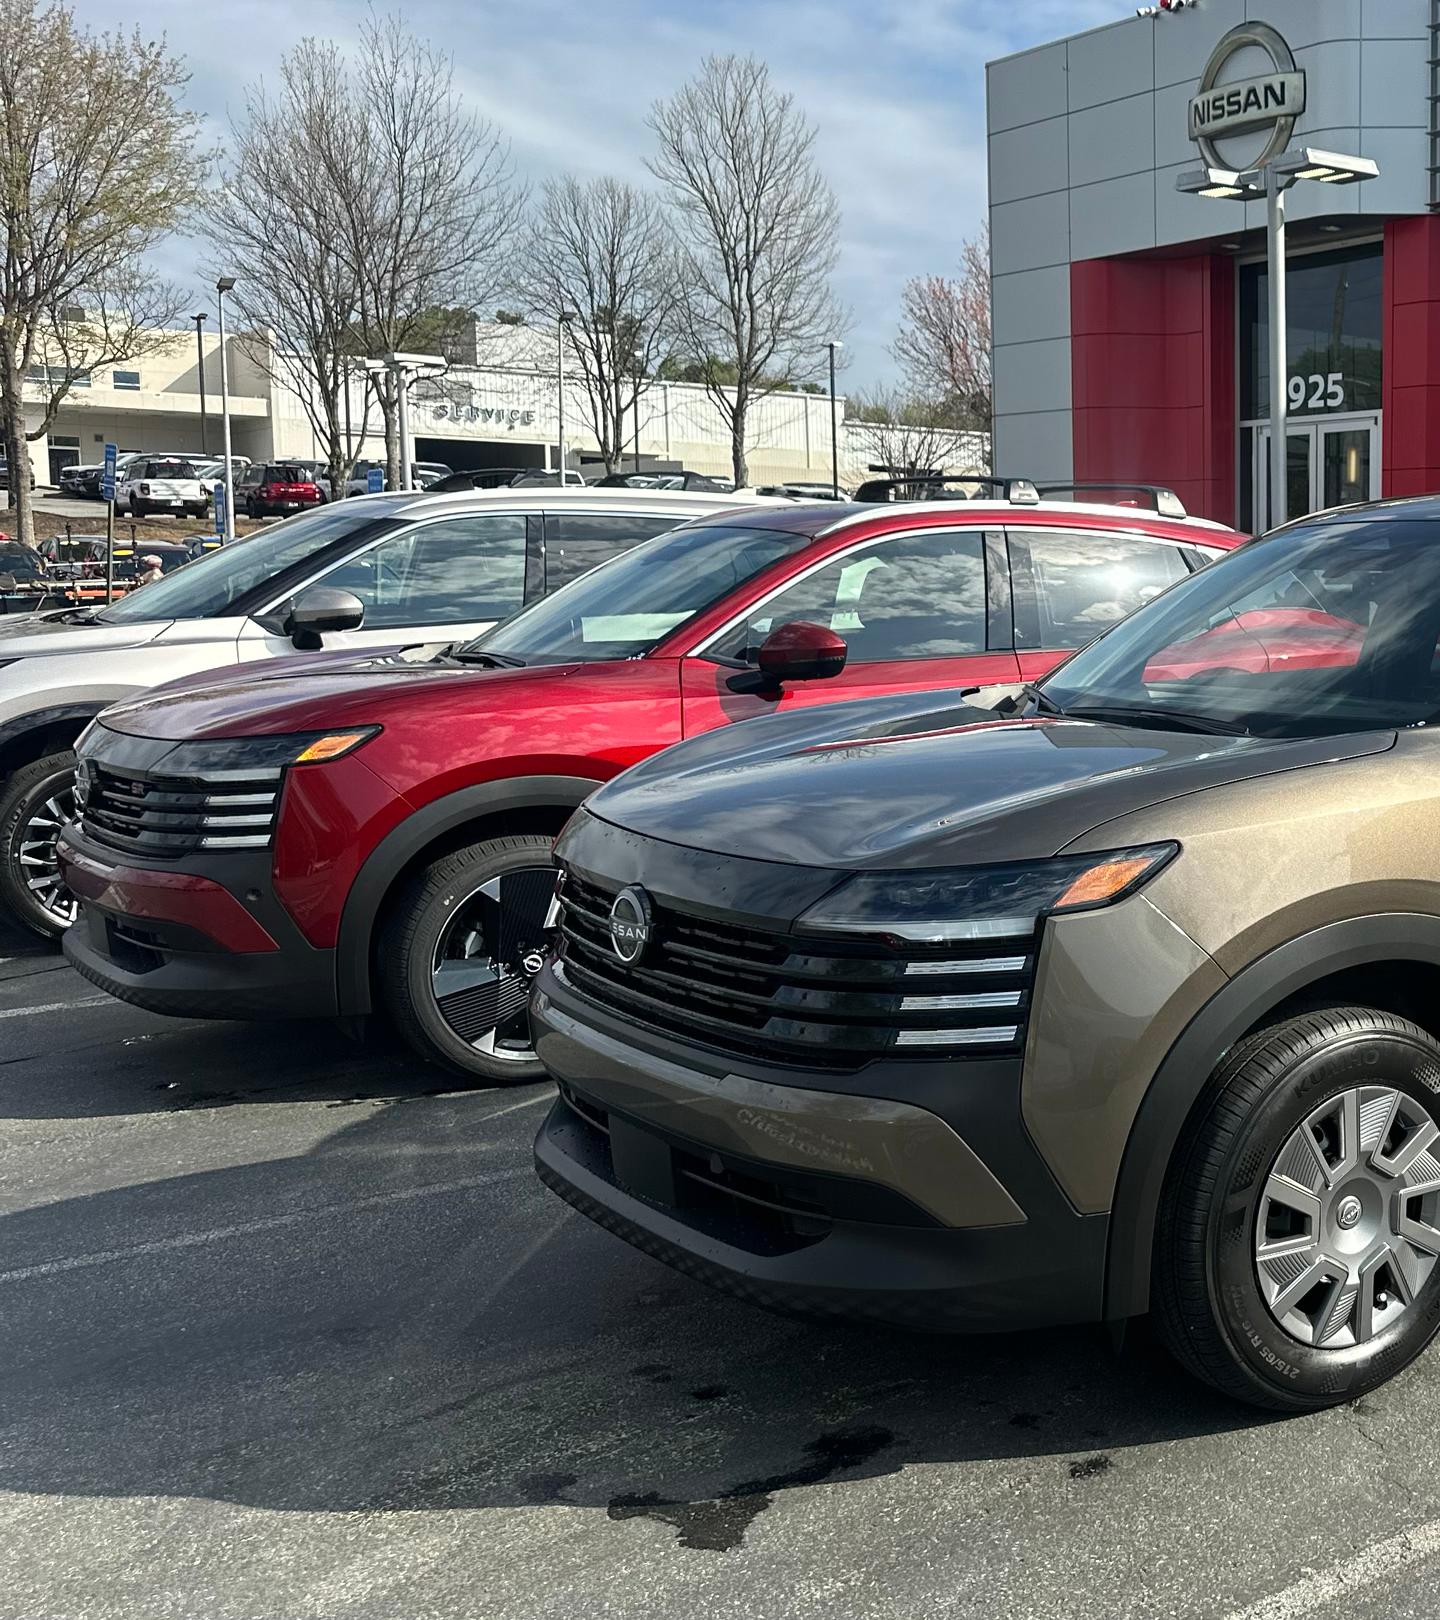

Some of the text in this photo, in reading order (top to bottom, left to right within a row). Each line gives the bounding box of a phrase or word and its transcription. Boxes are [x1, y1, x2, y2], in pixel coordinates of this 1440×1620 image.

[1193, 81, 1286, 129] NISSAN
[1287, 372, 1344, 411] 925
[436, 405, 535, 422] SERVICE
[612, 922, 646, 940] SSAN
